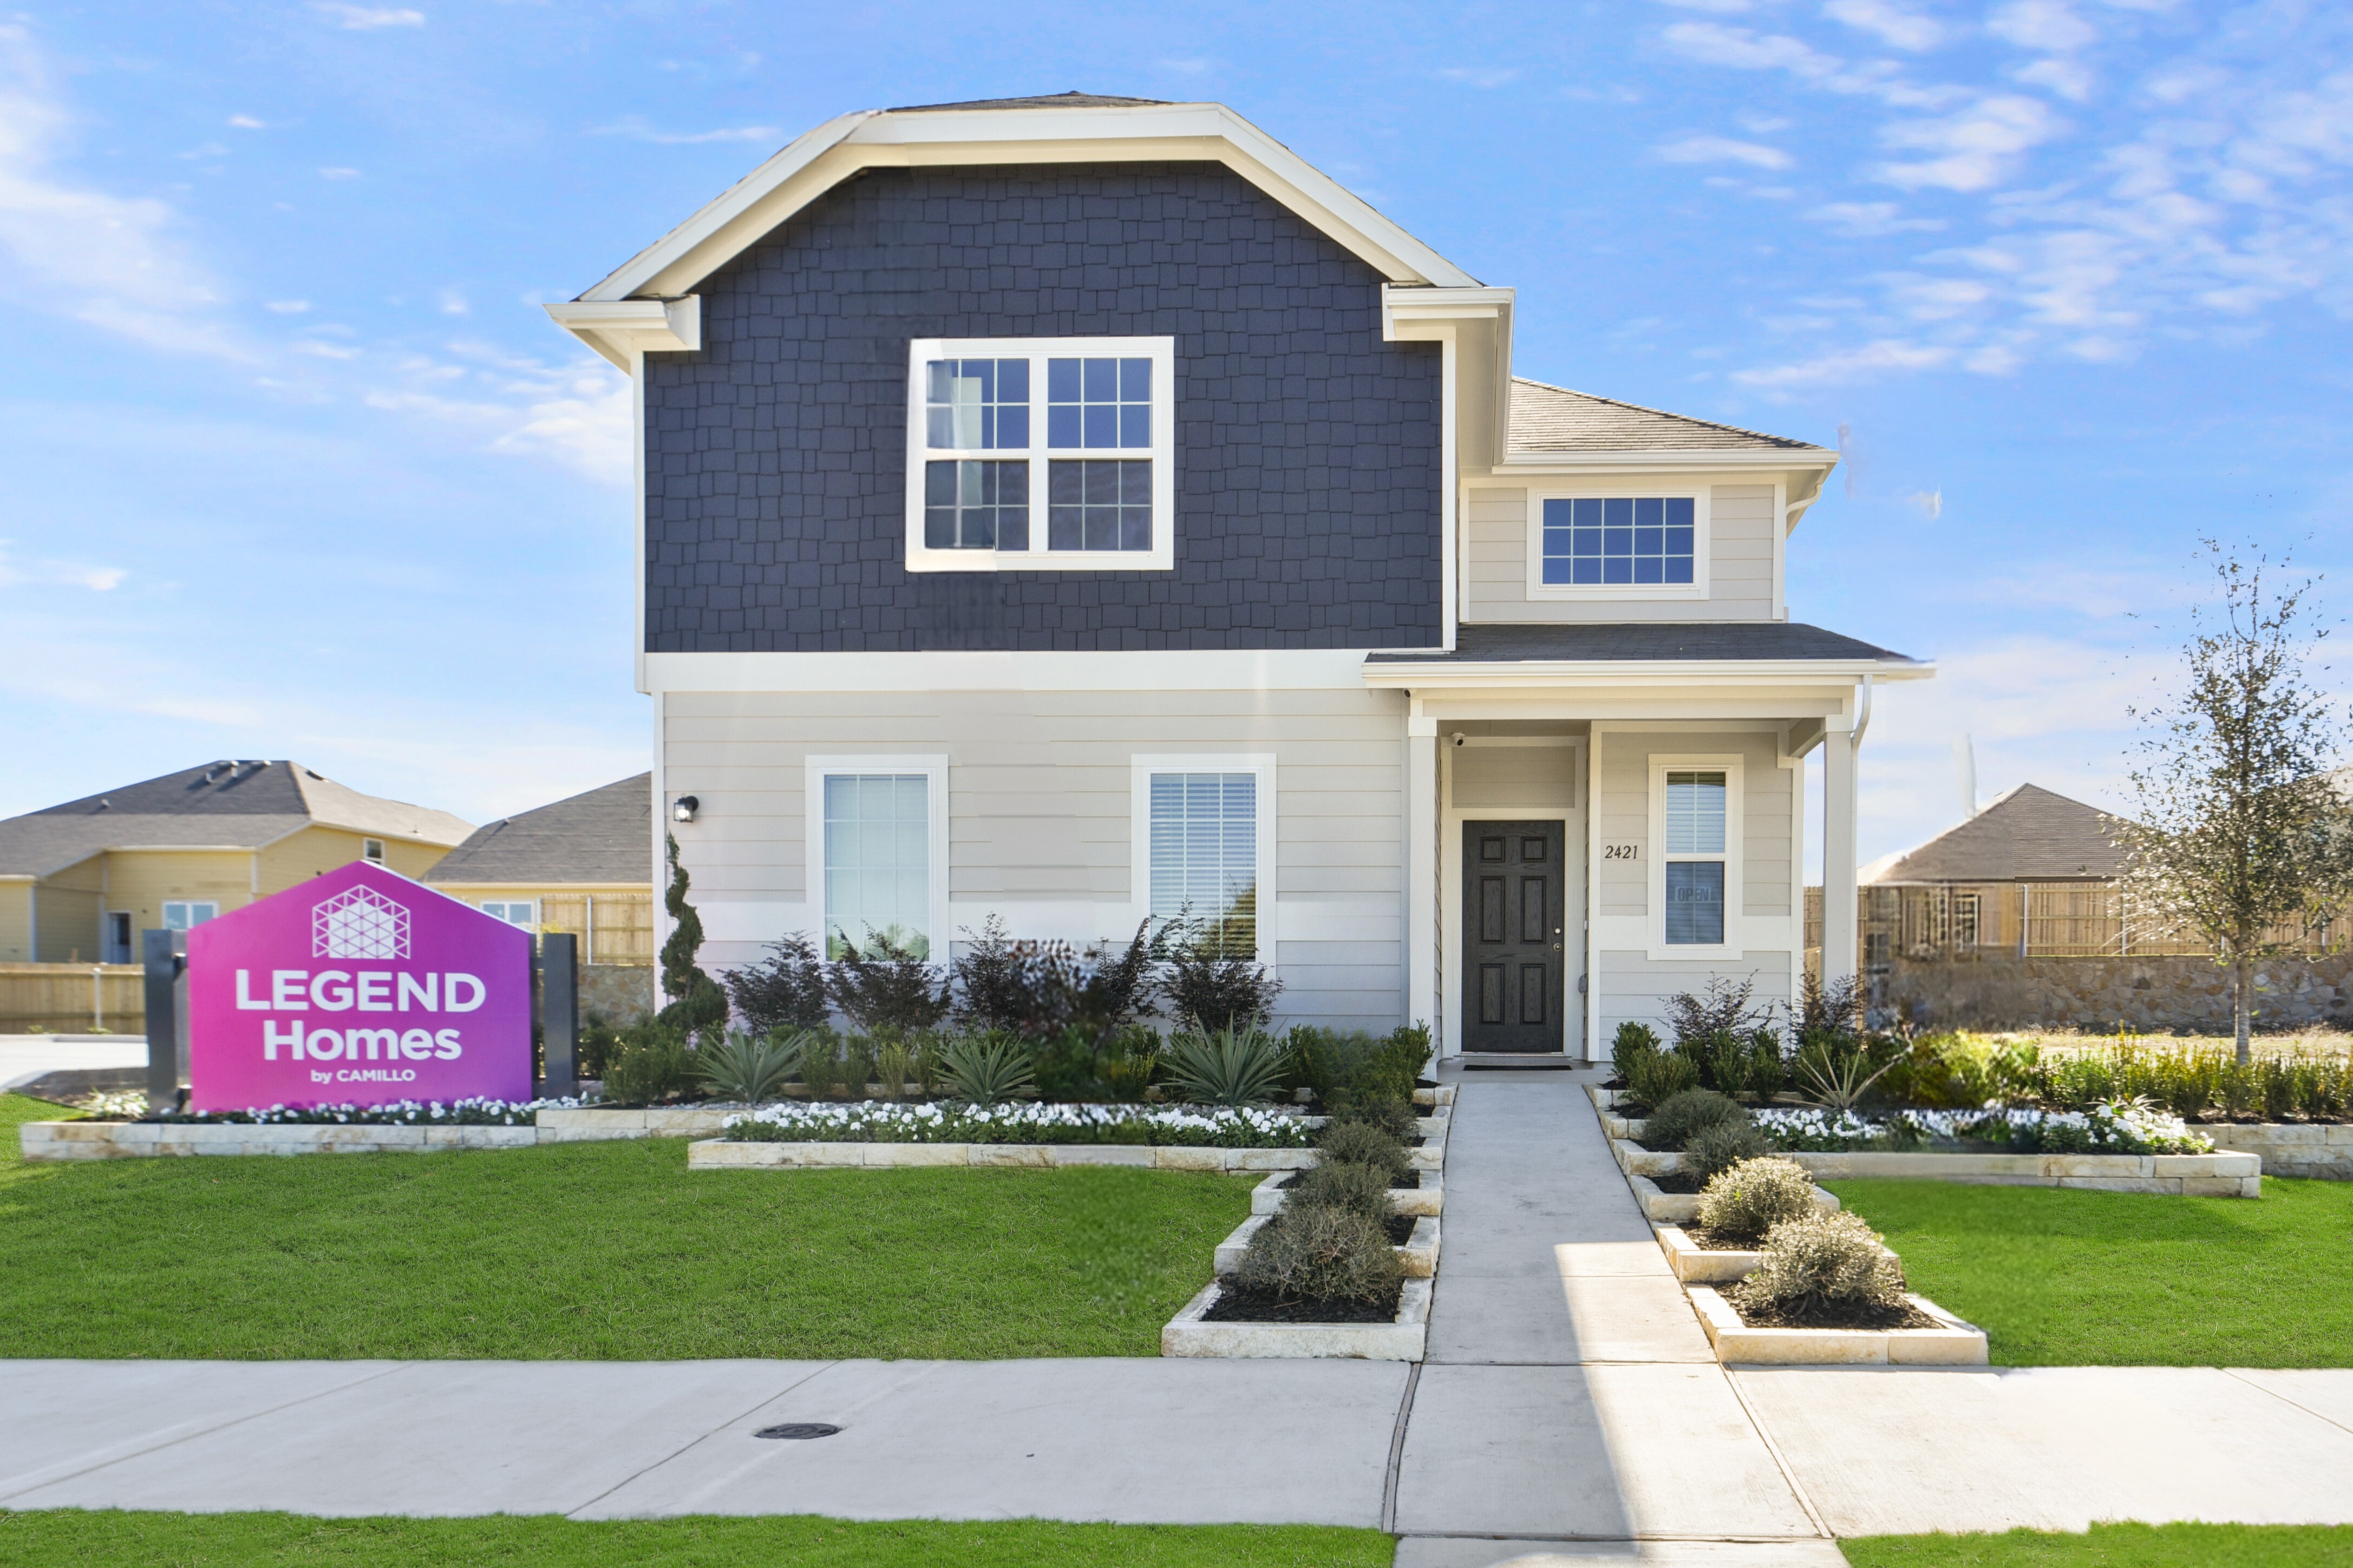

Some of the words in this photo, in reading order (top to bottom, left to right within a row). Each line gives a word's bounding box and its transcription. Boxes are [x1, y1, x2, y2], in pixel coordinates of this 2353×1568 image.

[1604, 845, 1638, 860] 2421
[1677, 887, 1709, 902] OPEN
[236, 969, 487, 1013] LEGEND
[263, 1020, 462, 1061] Homes
[311, 1069, 332, 1085] by
[336, 1070, 416, 1082] CAMILLO
